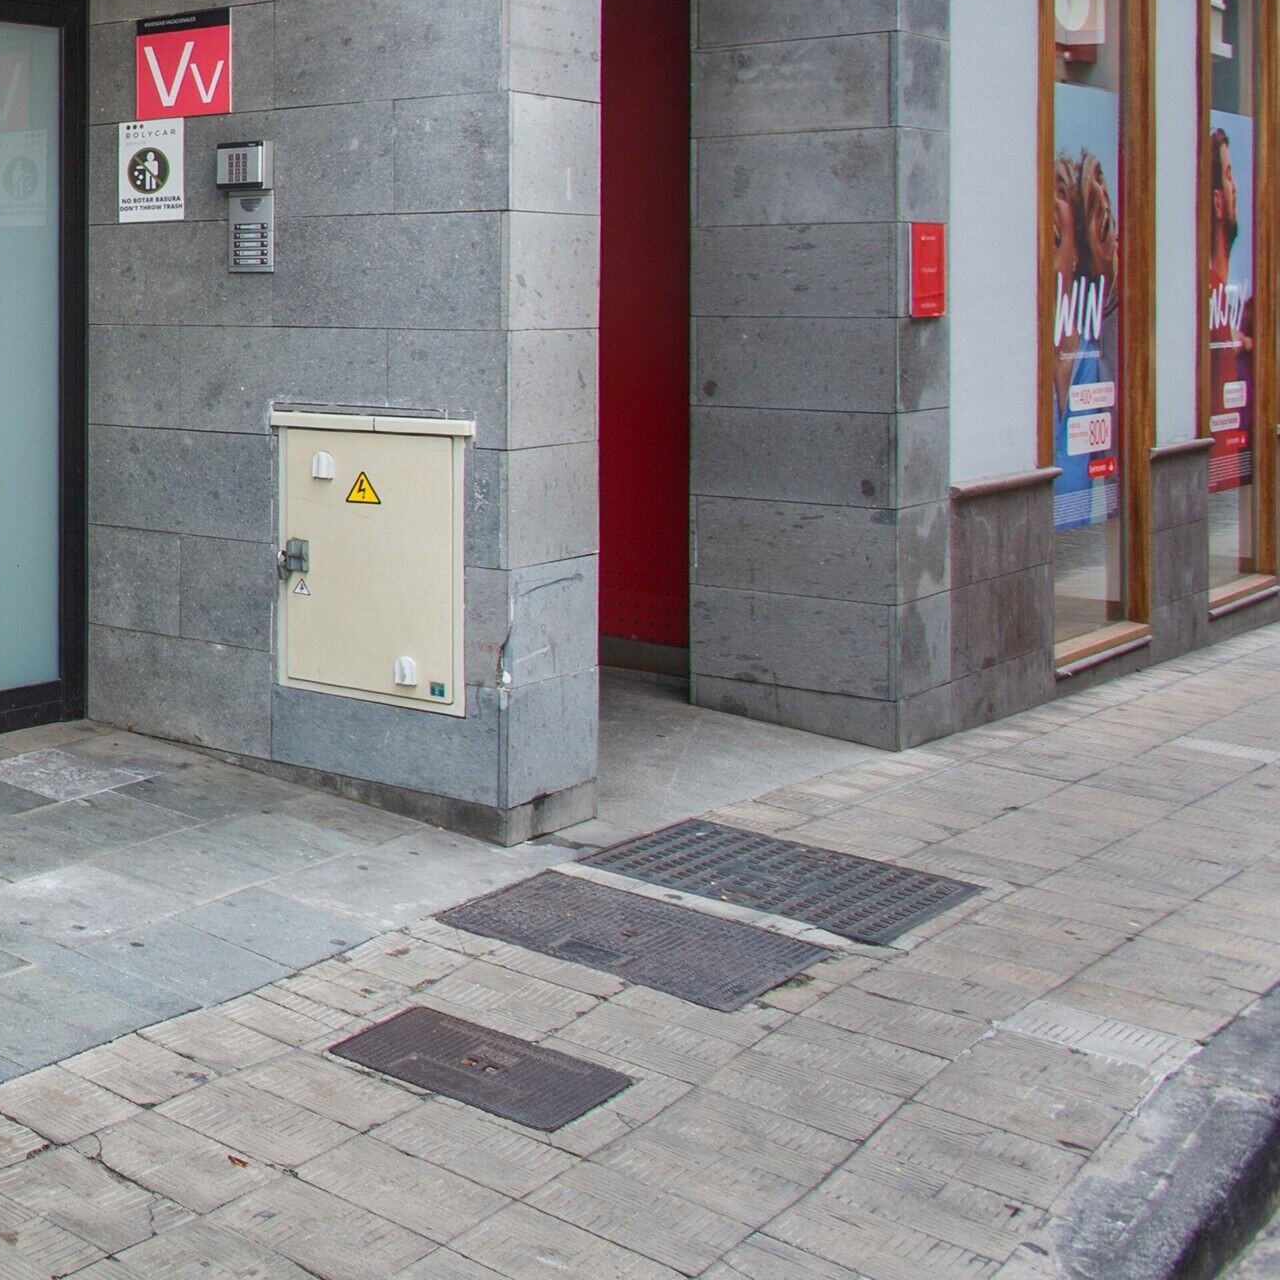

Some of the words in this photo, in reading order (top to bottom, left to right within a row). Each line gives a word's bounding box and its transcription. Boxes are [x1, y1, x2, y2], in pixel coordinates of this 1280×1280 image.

[143, 41, 224, 107] Vv
[125, 128, 176, 139] ROLYCAR
[133, 196, 154, 204] BOTAR
[1054, 271, 1105, 347] WIN
[1209, 279, 1248, 330] NJOY
